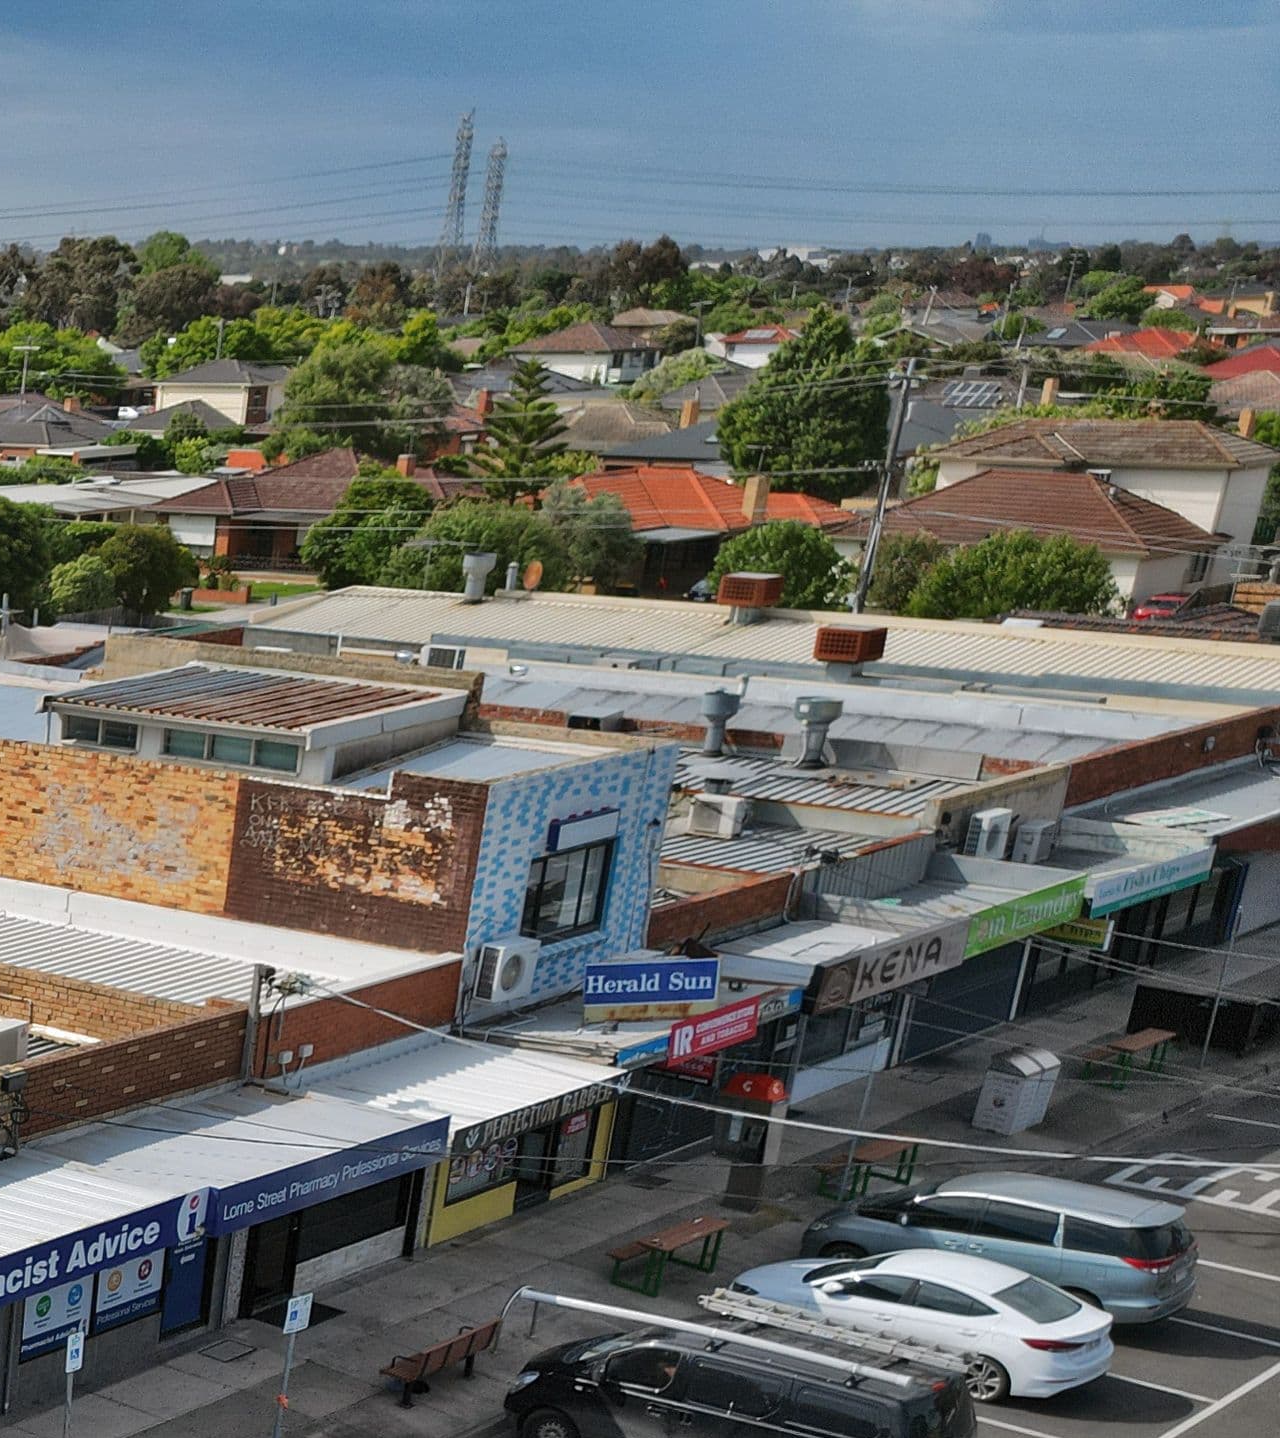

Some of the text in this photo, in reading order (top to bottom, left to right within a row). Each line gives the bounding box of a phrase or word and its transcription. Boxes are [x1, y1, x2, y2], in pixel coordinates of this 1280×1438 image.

[585, 971, 712, 994] Herald Sun
[857, 936, 942, 991] KENA
[223, 1200, 255, 1221] Lorne
[257, 1186, 288, 1210] Street
[289, 1172, 341, 1200] Pharmacy
[342, 1151, 400, 1182] Professional
[66, 1220, 161, 1273] Advice
